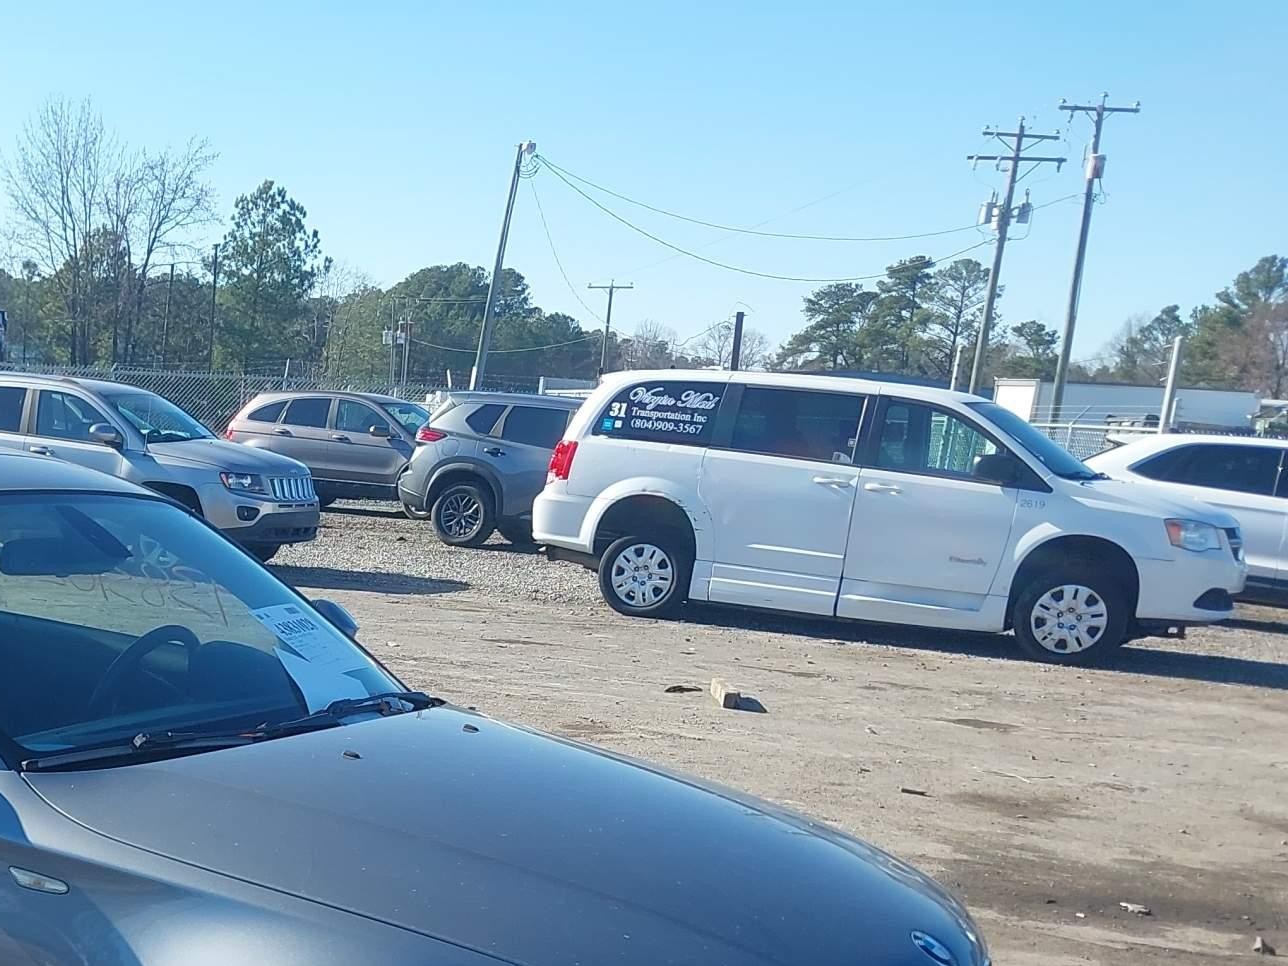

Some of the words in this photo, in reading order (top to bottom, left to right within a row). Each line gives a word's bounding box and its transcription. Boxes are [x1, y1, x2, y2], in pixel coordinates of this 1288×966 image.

[609, 402, 628, 418] 31
[631, 407, 692, 421] Transportation
[693, 412, 708, 423] Inc
[631, 418, 703, 435] (804)909-3567
[1020, 499, 1046, 510] 2619
